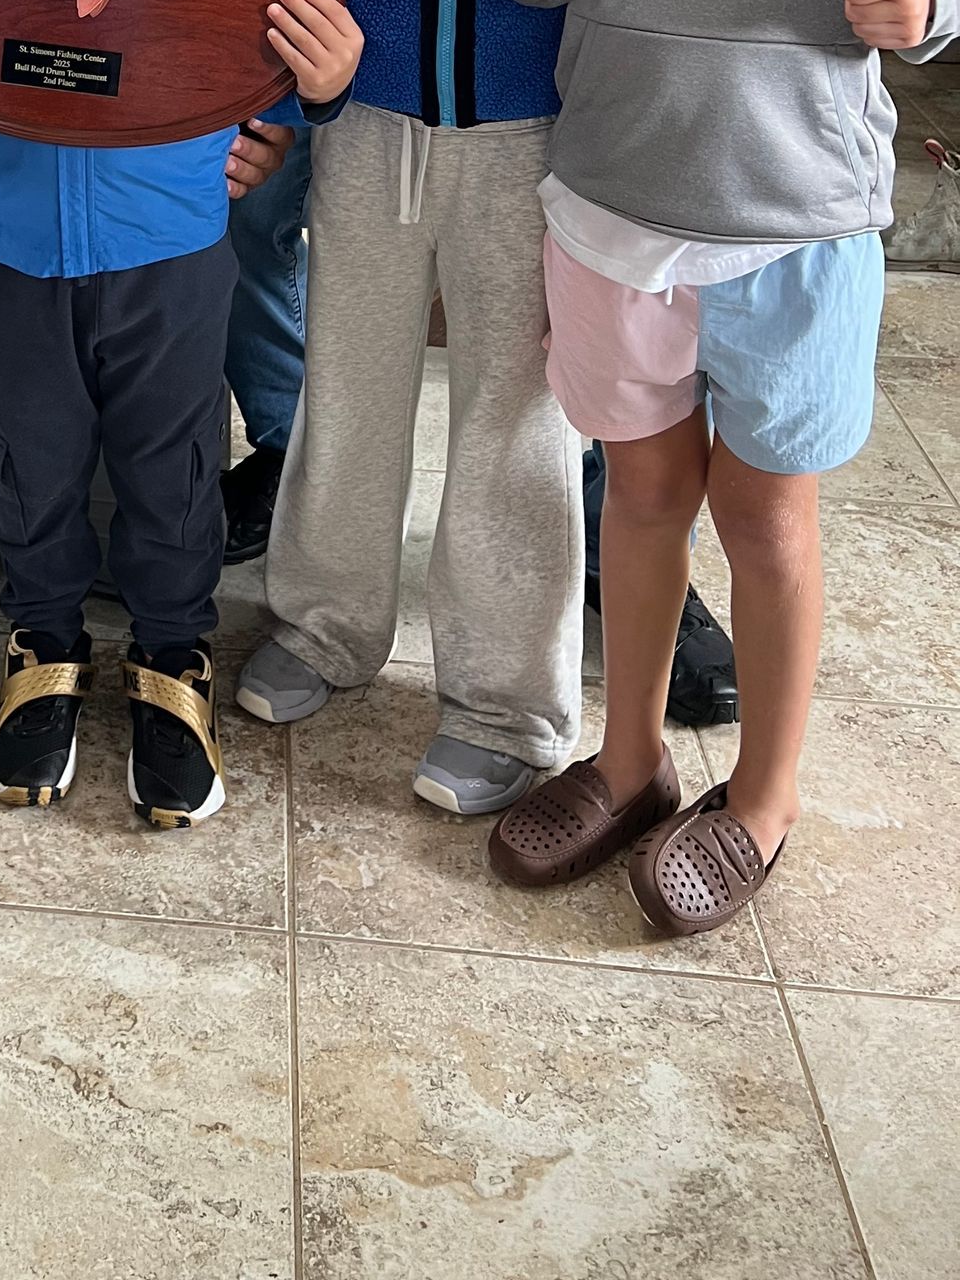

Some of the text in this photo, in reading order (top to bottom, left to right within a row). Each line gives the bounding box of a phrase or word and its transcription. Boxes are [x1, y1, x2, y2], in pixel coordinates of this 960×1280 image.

[19, 44, 107, 63] St. Simons Fishing Center
[53, 59, 71, 68] 2025
[14, 62, 108, 82] Bull Red Drum Tournament
[43, 76, 77, 87] 2nd Place
